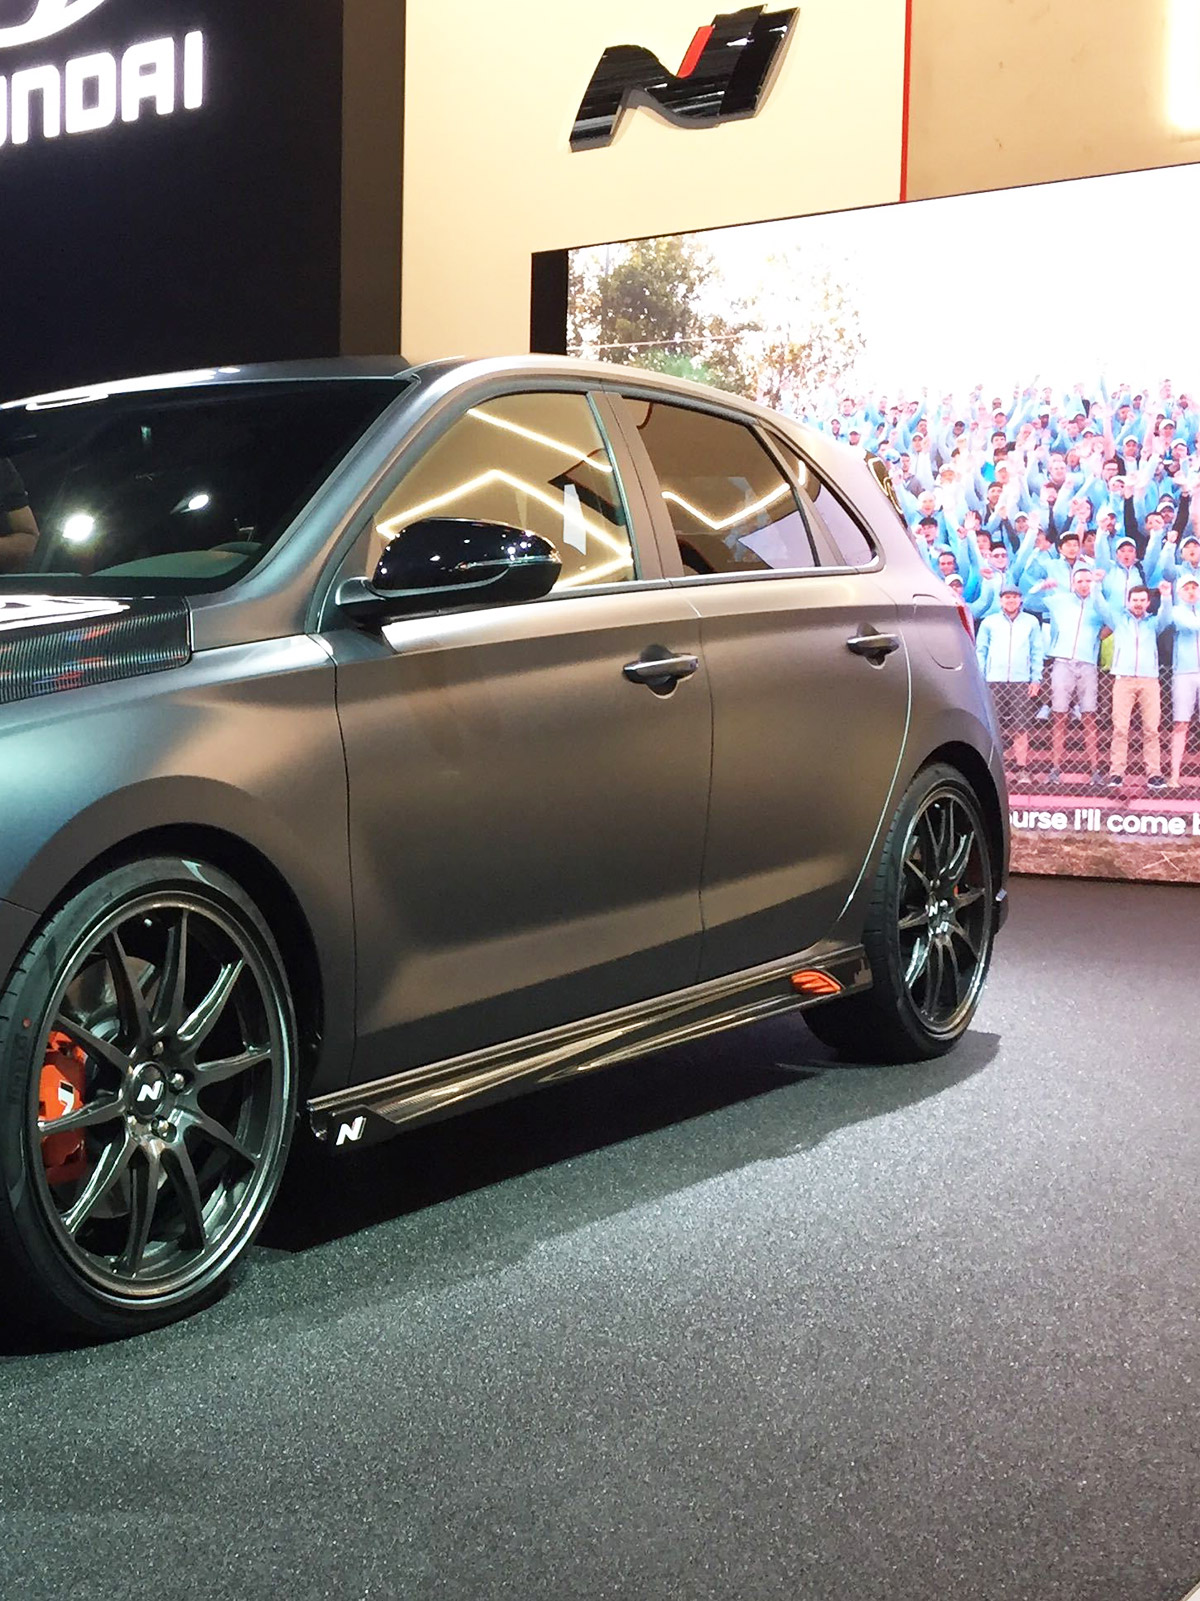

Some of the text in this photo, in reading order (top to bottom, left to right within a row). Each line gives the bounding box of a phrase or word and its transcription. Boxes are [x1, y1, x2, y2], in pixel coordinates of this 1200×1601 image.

[1074, 809, 1101, 831] I'll
[1106, 814, 1186, 836] come
[336, 1116, 367, 1146] N
